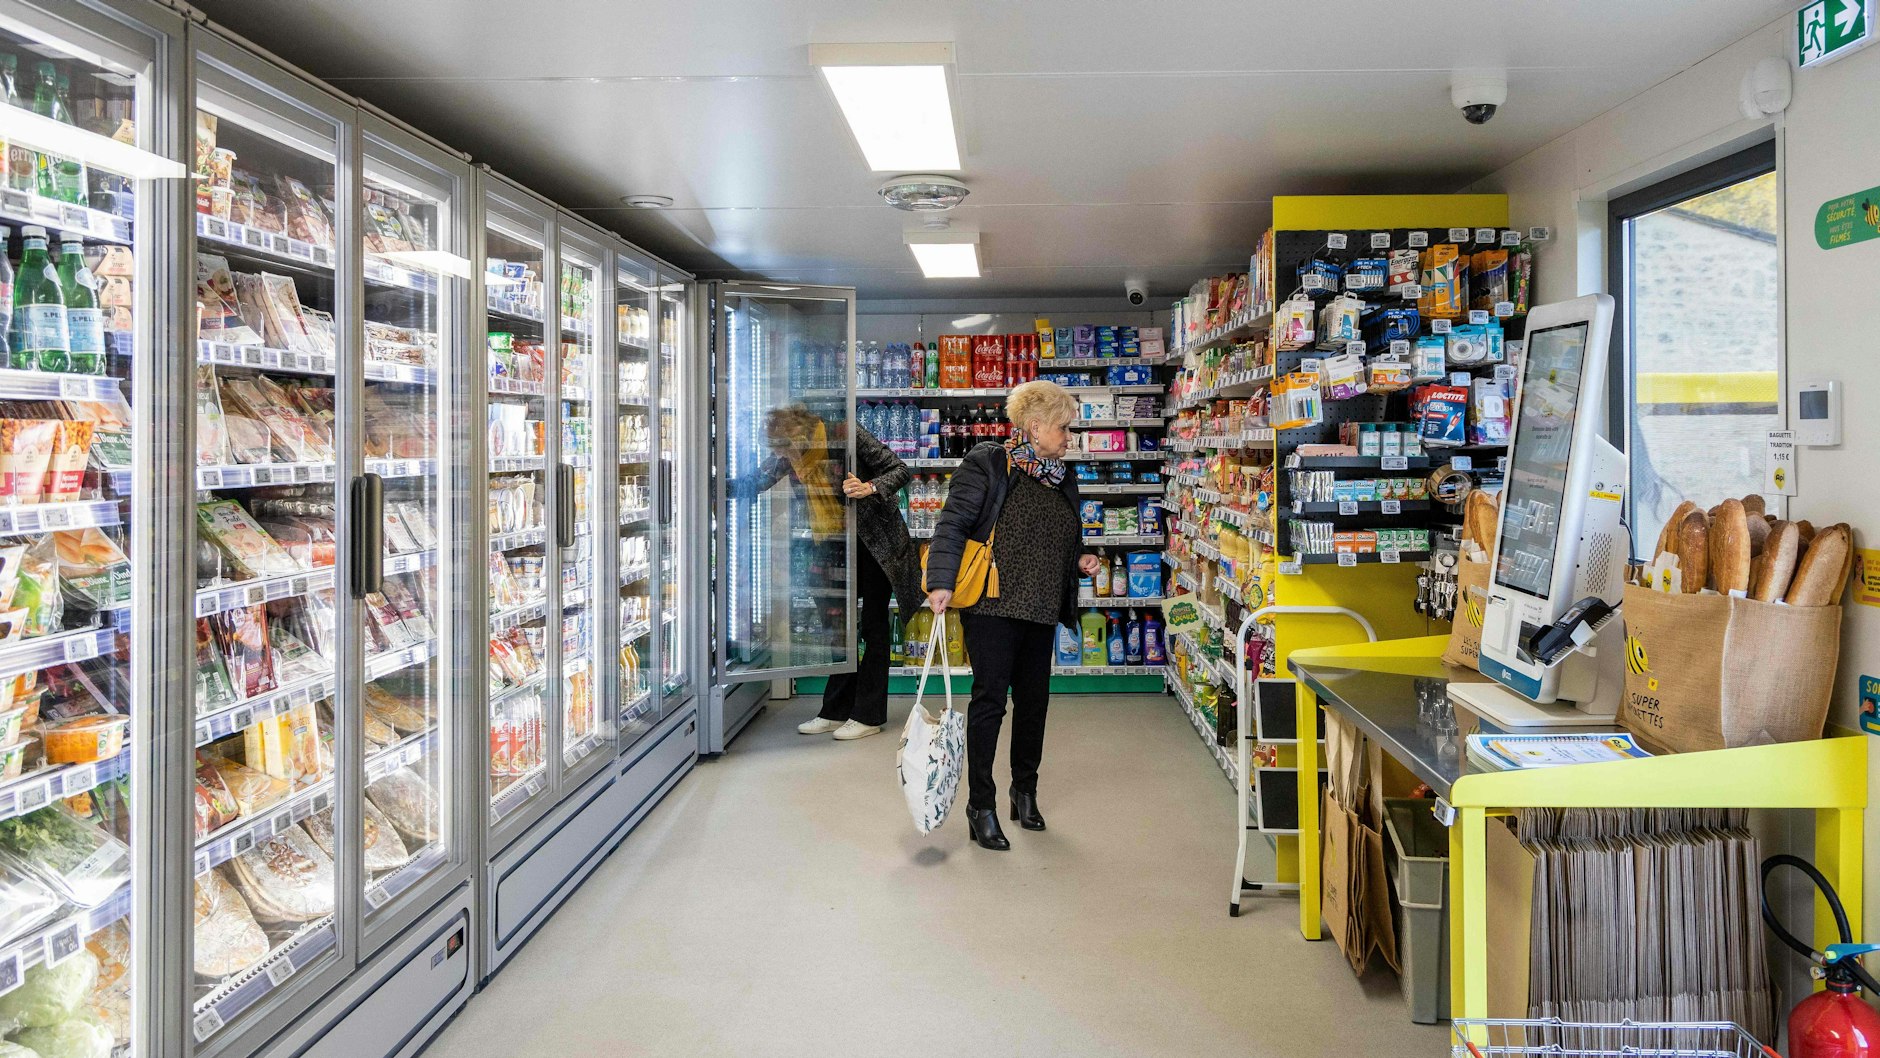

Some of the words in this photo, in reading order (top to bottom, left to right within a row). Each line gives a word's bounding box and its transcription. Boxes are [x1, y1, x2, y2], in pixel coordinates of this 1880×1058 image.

[1390, 255, 1418, 267] Energizer
[1430, 391, 1466, 402] LOCTITE
[1774, 454, 1785, 462] 1,15
[1776, 474, 1784, 483] Api
[1631, 692, 1660, 712] SUPER
